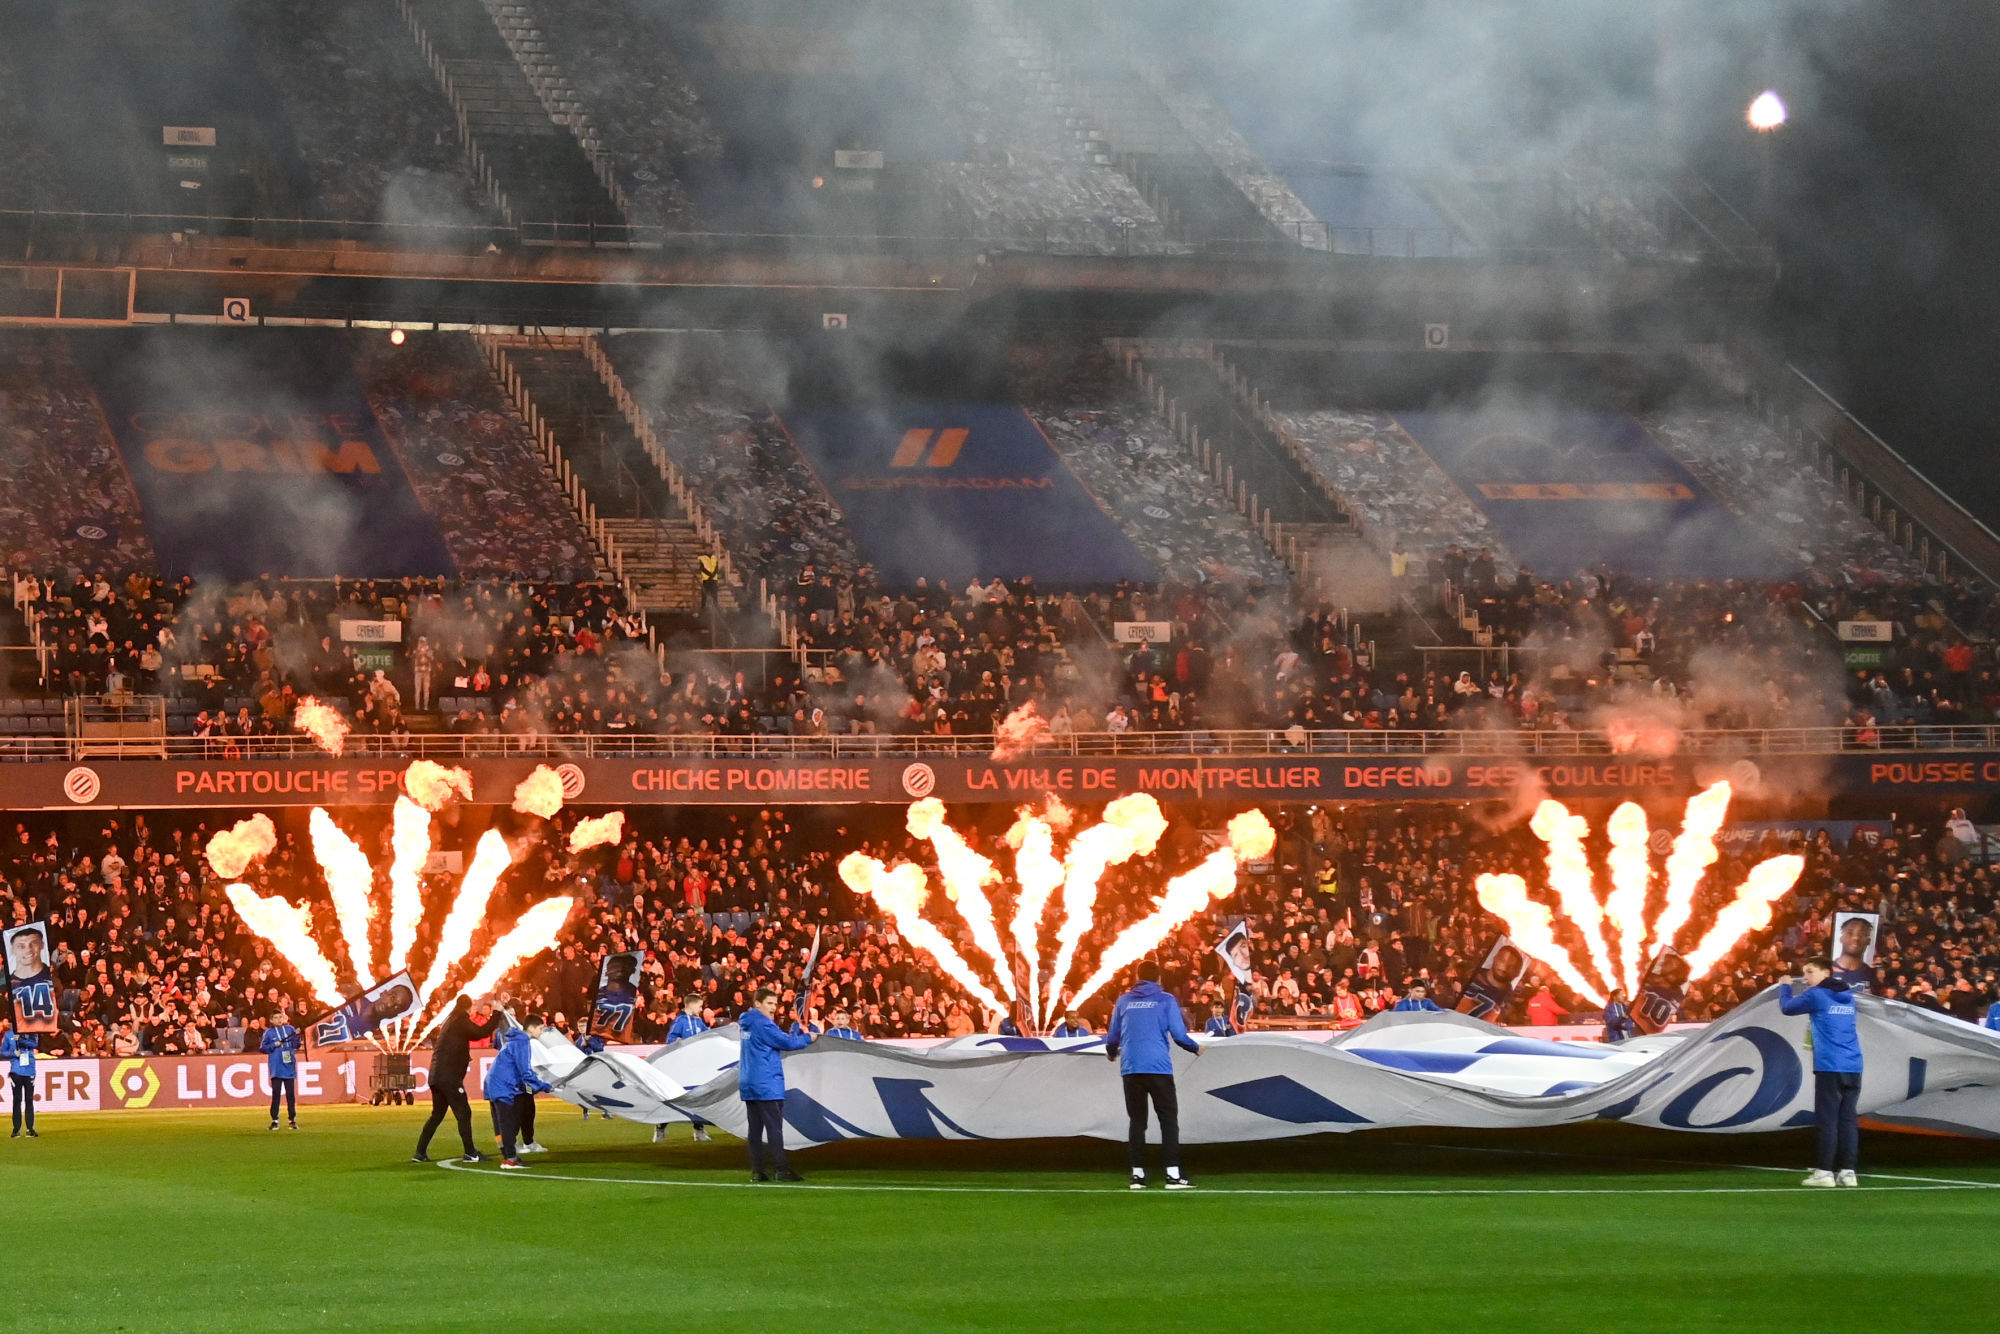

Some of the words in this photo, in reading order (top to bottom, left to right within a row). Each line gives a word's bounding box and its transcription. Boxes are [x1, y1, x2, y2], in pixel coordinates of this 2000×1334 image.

[228, 301, 246, 322] Q
[1429, 326, 1444, 345] O
[144, 438, 382, 474] GRIM
[357, 654, 392, 667] ORTIE
[176, 770, 348, 793] PARTOUCHE
[632, 768, 720, 791] CHICHE
[727, 768, 870, 791] PLOMBERIE
[966, 768, 998, 789] LA
[1004, 767, 1073, 789] VILLE
[1082, 767, 1116, 789] DE
[1139, 766, 1321, 789] MONTPELLIER
[1344, 766, 1451, 788] DEFEND
[1466, 766, 1521, 787] SES
[1537, 765, 1675, 787] COULEURS
[1870, 762, 1975, 784] POUSSE
[1982, 762, 2000, 782] C
[16, 983, 54, 1018] 14
[1640, 991, 1673, 1028] 10
[177, 1061, 323, 1099] LIGUE
[337, 1060, 356, 1094] 1
